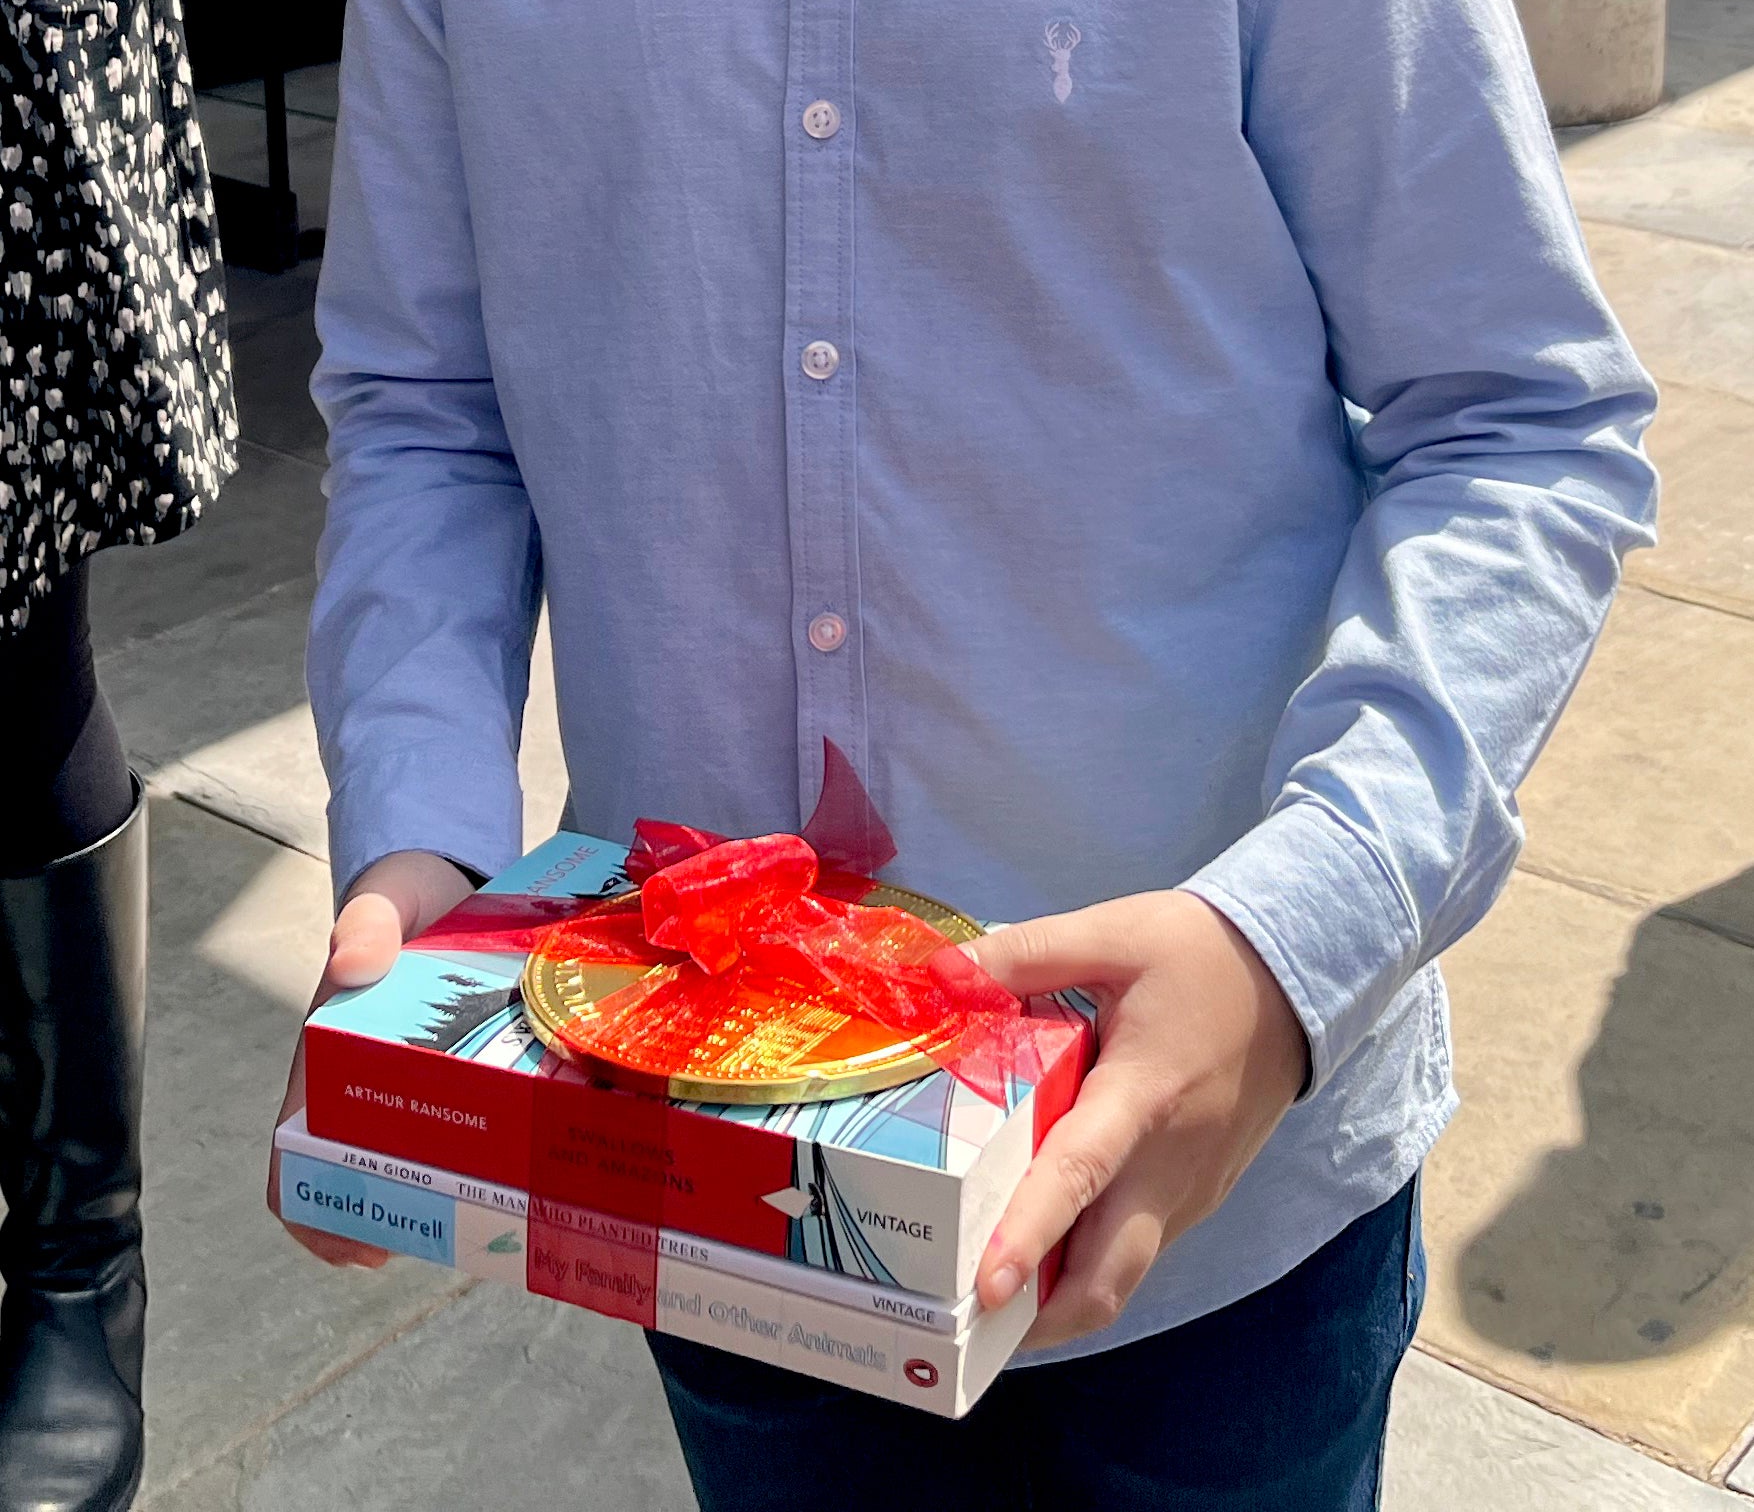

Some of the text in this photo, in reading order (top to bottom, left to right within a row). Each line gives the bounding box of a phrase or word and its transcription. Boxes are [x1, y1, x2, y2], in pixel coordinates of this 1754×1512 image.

[344, 1084, 488, 1131] ARTHUR RANSOME
[342, 1151, 433, 1186] JEAN GIONO
[548, 1144, 696, 1194] AND AMAZONS
[568, 1126, 675, 1167] SWALLOWS
[296, 1181, 443, 1239] Gerald Durrell
[456, 1180, 709, 1263] THE MAN WHO PLANTED TREES
[856, 1207, 934, 1242] VINTAGE
[534, 1246, 888, 1372] My Family and Other Animals
[872, 1295, 937, 1325] VINTAGE
